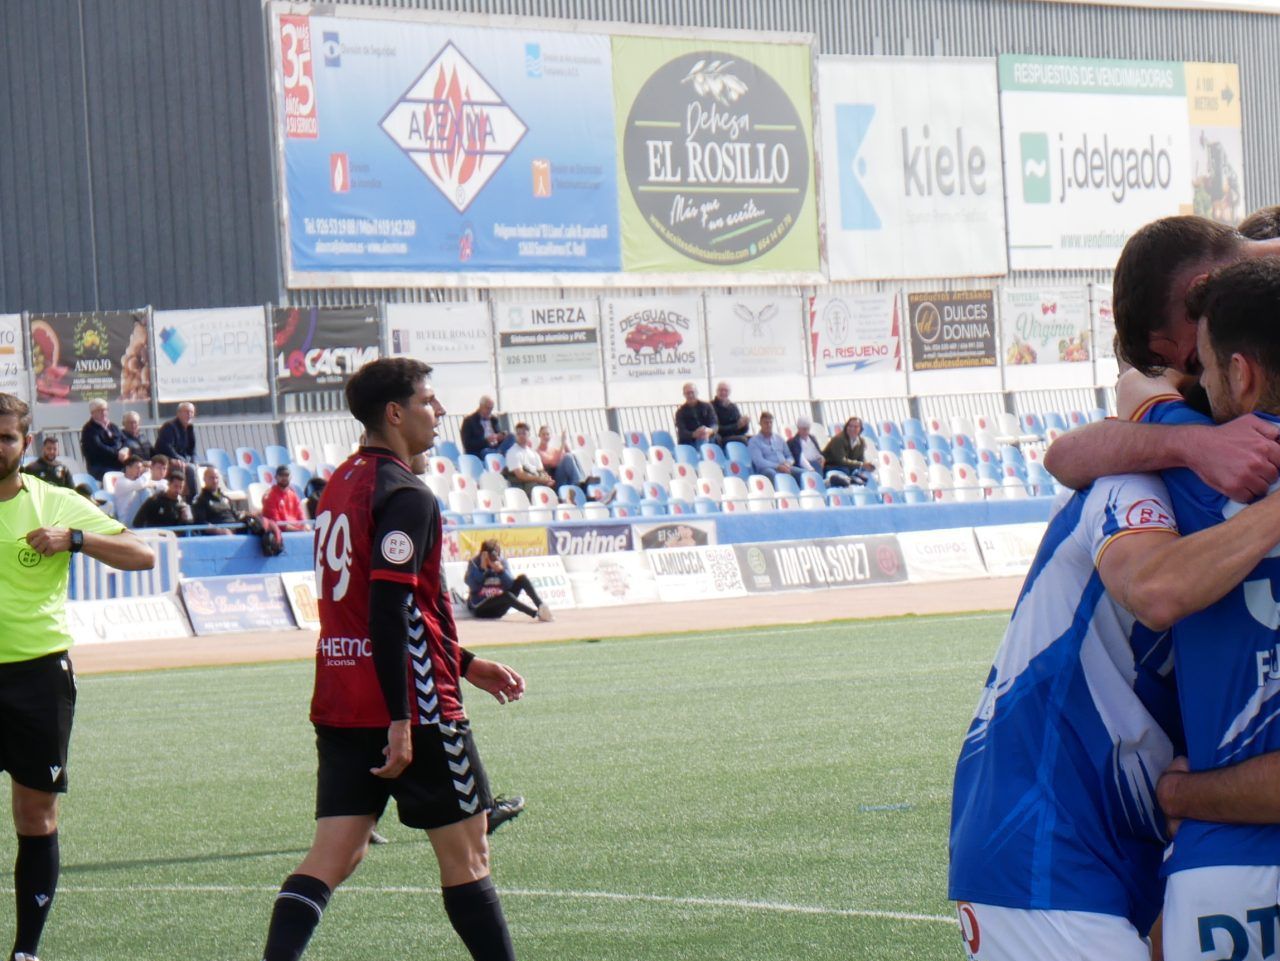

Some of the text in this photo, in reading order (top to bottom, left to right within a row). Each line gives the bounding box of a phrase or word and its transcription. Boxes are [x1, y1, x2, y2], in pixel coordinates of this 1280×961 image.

[282, 23, 315, 116] 35
[1080, 66, 1096, 87] DE
[1096, 67, 1174, 90] VENDIMIADORAS
[686, 100, 751, 140] Dehesa
[645, 139, 790, 184] EL ROSILLO
[901, 121, 988, 198] kiele
[1058, 133, 1172, 205] j.delgado
[531, 307, 587, 325] INERZA
[619, 309, 690, 333] DESGUACES
[944, 304, 988, 322] DULCES
[943, 323, 991, 341] DONINA
[1015, 311, 1076, 348] Virginia
[74, 359, 112, 373] ANTOJO
[618, 351, 696, 366] CASTELLANOS
[554, 526, 629, 556] Ontime
[650, 551, 706, 576] LAMUCCA
[773, 543, 871, 586] IMPULSO27
